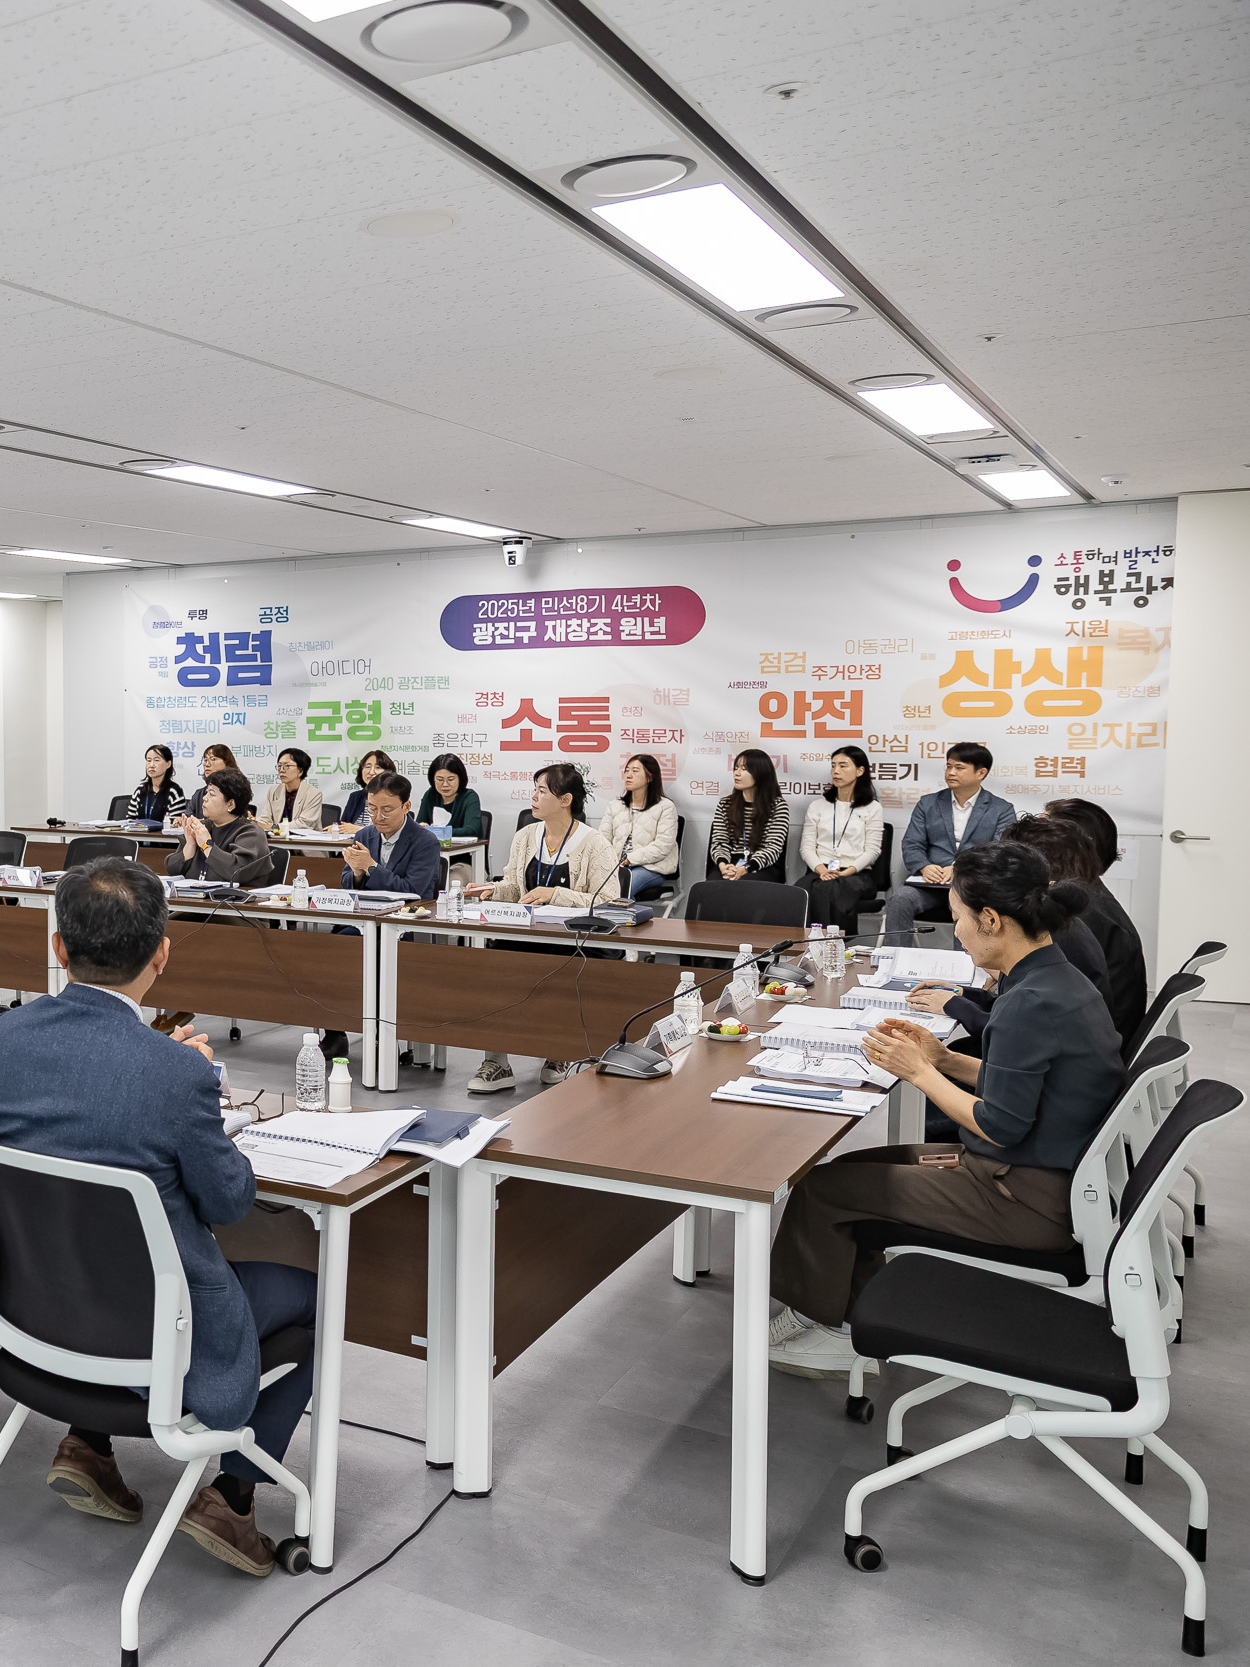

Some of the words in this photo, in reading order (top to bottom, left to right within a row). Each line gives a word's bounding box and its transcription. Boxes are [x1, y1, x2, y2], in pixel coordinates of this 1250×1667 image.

[1054, 547, 1118, 573] 소통하며
[478, 598, 535, 619] 2025년
[541, 594, 605, 616] 민선8기
[611, 593, 661, 613] 4년차
[188, 609, 208, 620] 투명
[258, 606, 289, 624] 공정
[472, 620, 537, 646] 광진구
[543, 617, 613, 642] 재창조
[619, 616, 667, 641] 원년
[947, 629, 1012, 642] 고령친화도시
[1065, 619, 1109, 638] 지원
[288, 640, 334, 652] 칭찬릴레이
[845, 637, 914, 655] 아동권리
[174, 630, 272, 688] 청렴
[310, 658, 371, 676] 아이디어
[758, 651, 807, 674] 점검
[811, 664, 882, 681] 주거안정
[365, 677, 394, 691] 2040
[398, 675, 450, 690] 광진플랜
[727, 681, 768, 690] 사회안전망
[939, 645, 1104, 718] 상생
[475, 692, 504, 707] 경청
[653, 687, 690, 707] 해결
[1117, 685, 1161, 699] 광진형
[146, 696, 197, 708] 종합청렴도
[200, 695, 239, 708] 2년연속
[242, 694, 268, 707] 1등급
[390, 701, 415, 716] 청년
[223, 712, 246, 726] 의지
[457, 713, 477, 724] 배려
[621, 706, 643, 717] 현장
[758, 689, 863, 739] 안전
[902, 704, 931, 719] 청년
[159, 719, 221, 734] 청렴지킴이
[306, 699, 382, 741] 균형
[500, 696, 611, 753] 소통
[263, 720, 297, 740] 창출
[390, 725, 414, 735] 재창조
[620, 728, 684, 744] 직통문자
[703, 730, 750, 743] 식품안전
[1005, 724, 1049, 735] 소상공인
[1067, 721, 1167, 750] 일자리
[432, 732, 488, 748] 좋은친구
[867, 734, 909, 753] 안심
[231, 744, 278, 758] 부패방지
[1034, 756, 1086, 778] 협력
[689, 780, 720, 796] 연결
[1058, 784, 1123, 796] 복지서비스
[484, 909, 528, 919] 어르신복지과장
